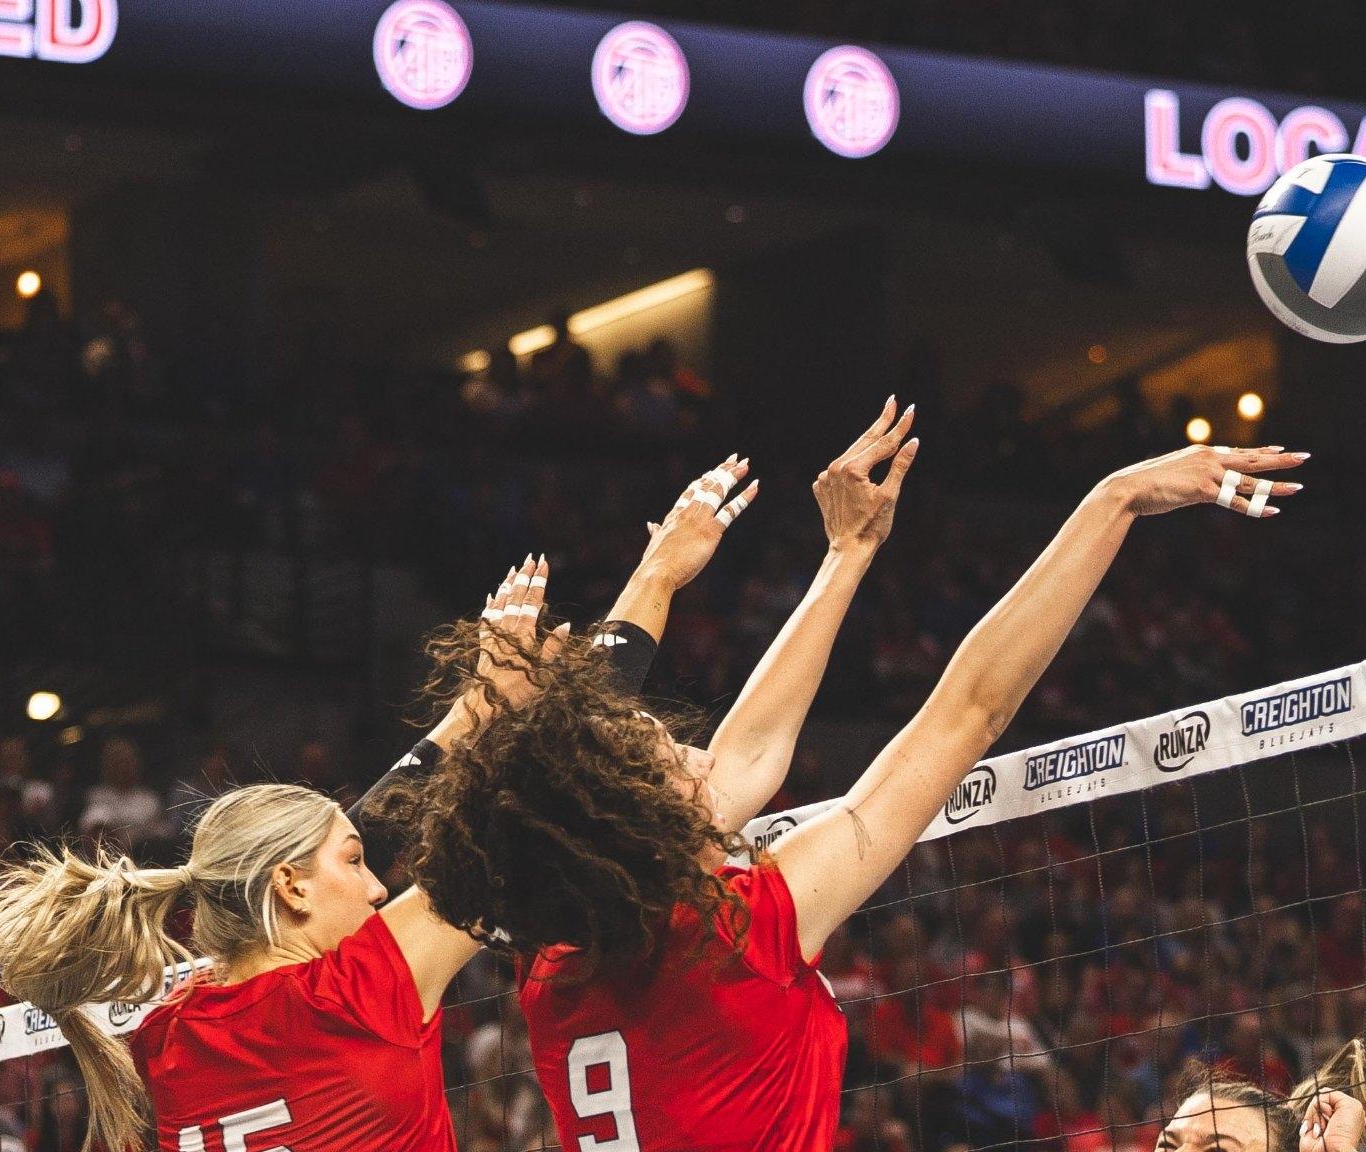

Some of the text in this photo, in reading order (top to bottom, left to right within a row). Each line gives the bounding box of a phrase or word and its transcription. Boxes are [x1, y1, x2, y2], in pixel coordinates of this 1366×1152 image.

[1241, 676, 1352, 736] CREIGHTON
[1158, 724, 1207, 761] RUNZA
[1259, 722, 1336, 750] BLUEJAYS
[1023, 734, 1126, 791] CREIGHTON
[948, 775, 992, 815] RUNZA
[1039, 777, 1107, 804] BLUEJAYS
